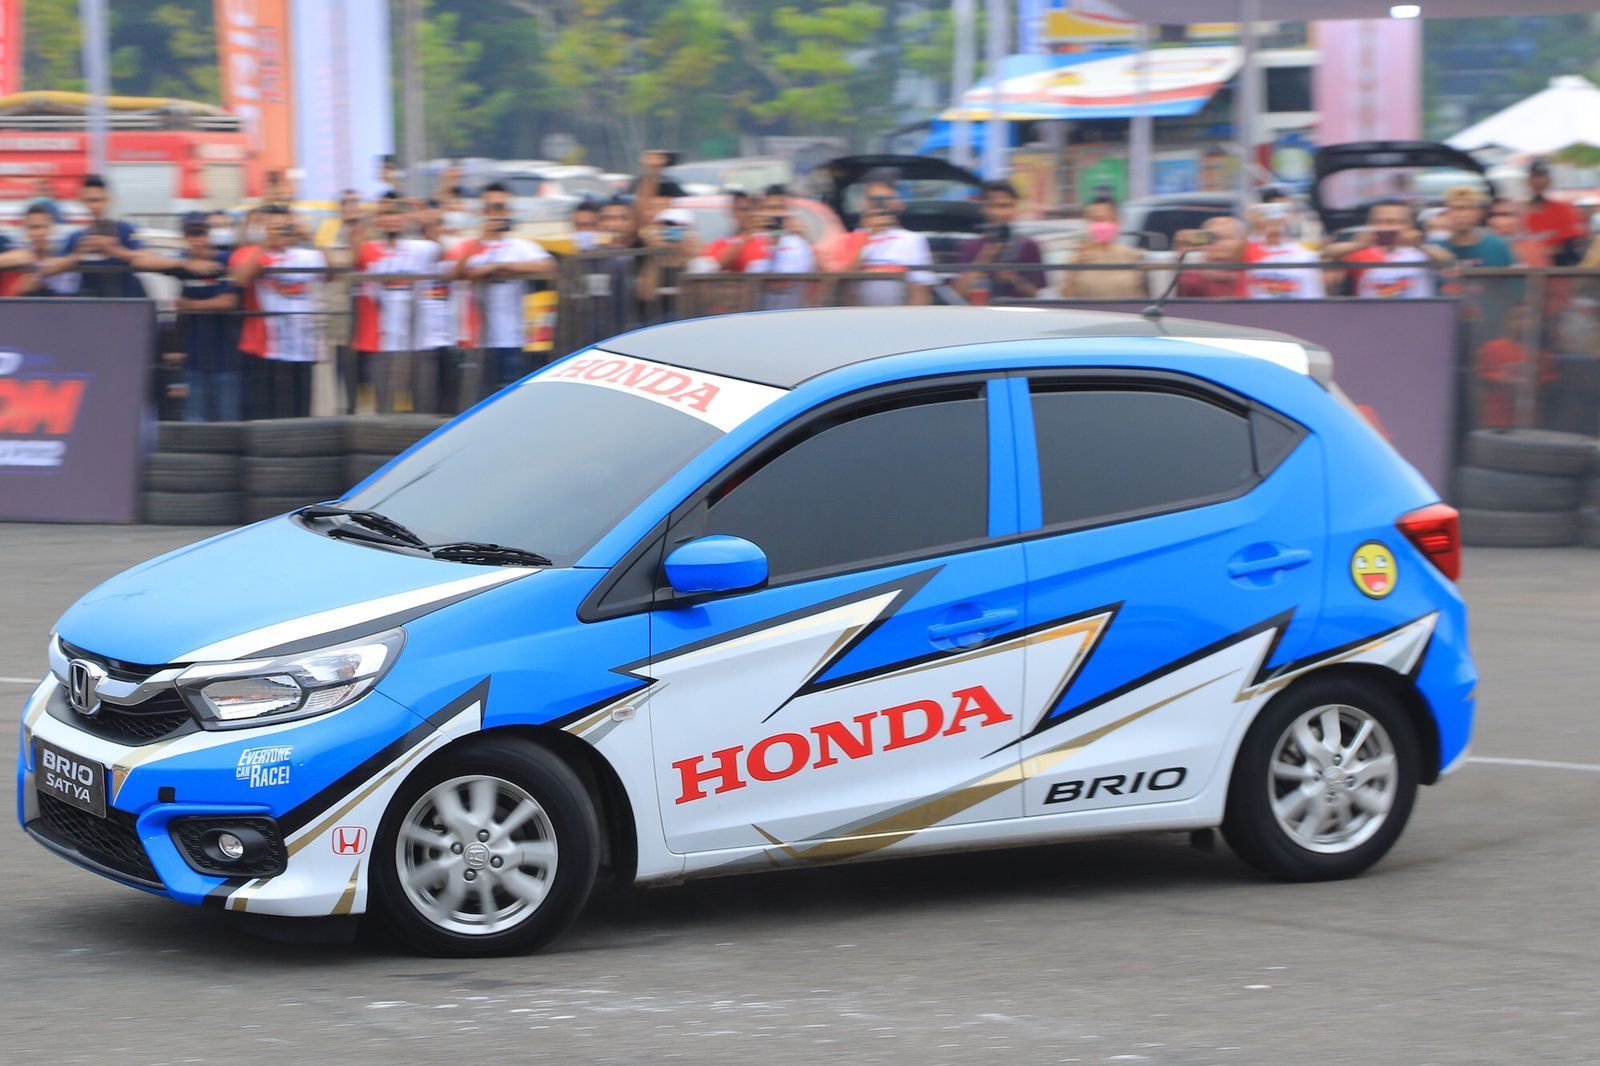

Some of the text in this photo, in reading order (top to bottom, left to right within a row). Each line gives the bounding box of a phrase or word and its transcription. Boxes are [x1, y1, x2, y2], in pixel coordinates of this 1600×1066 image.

[551, 359, 721, 413] HONDA
[237, 747, 294, 766] EVERYONE
[672, 685, 1013, 805] HONDA
[43, 748, 93, 786] BRIO
[236, 765, 290, 788] CAN RACE!
[1044, 767, 1188, 805] BRIO
[46, 772, 90, 803] SATYA
